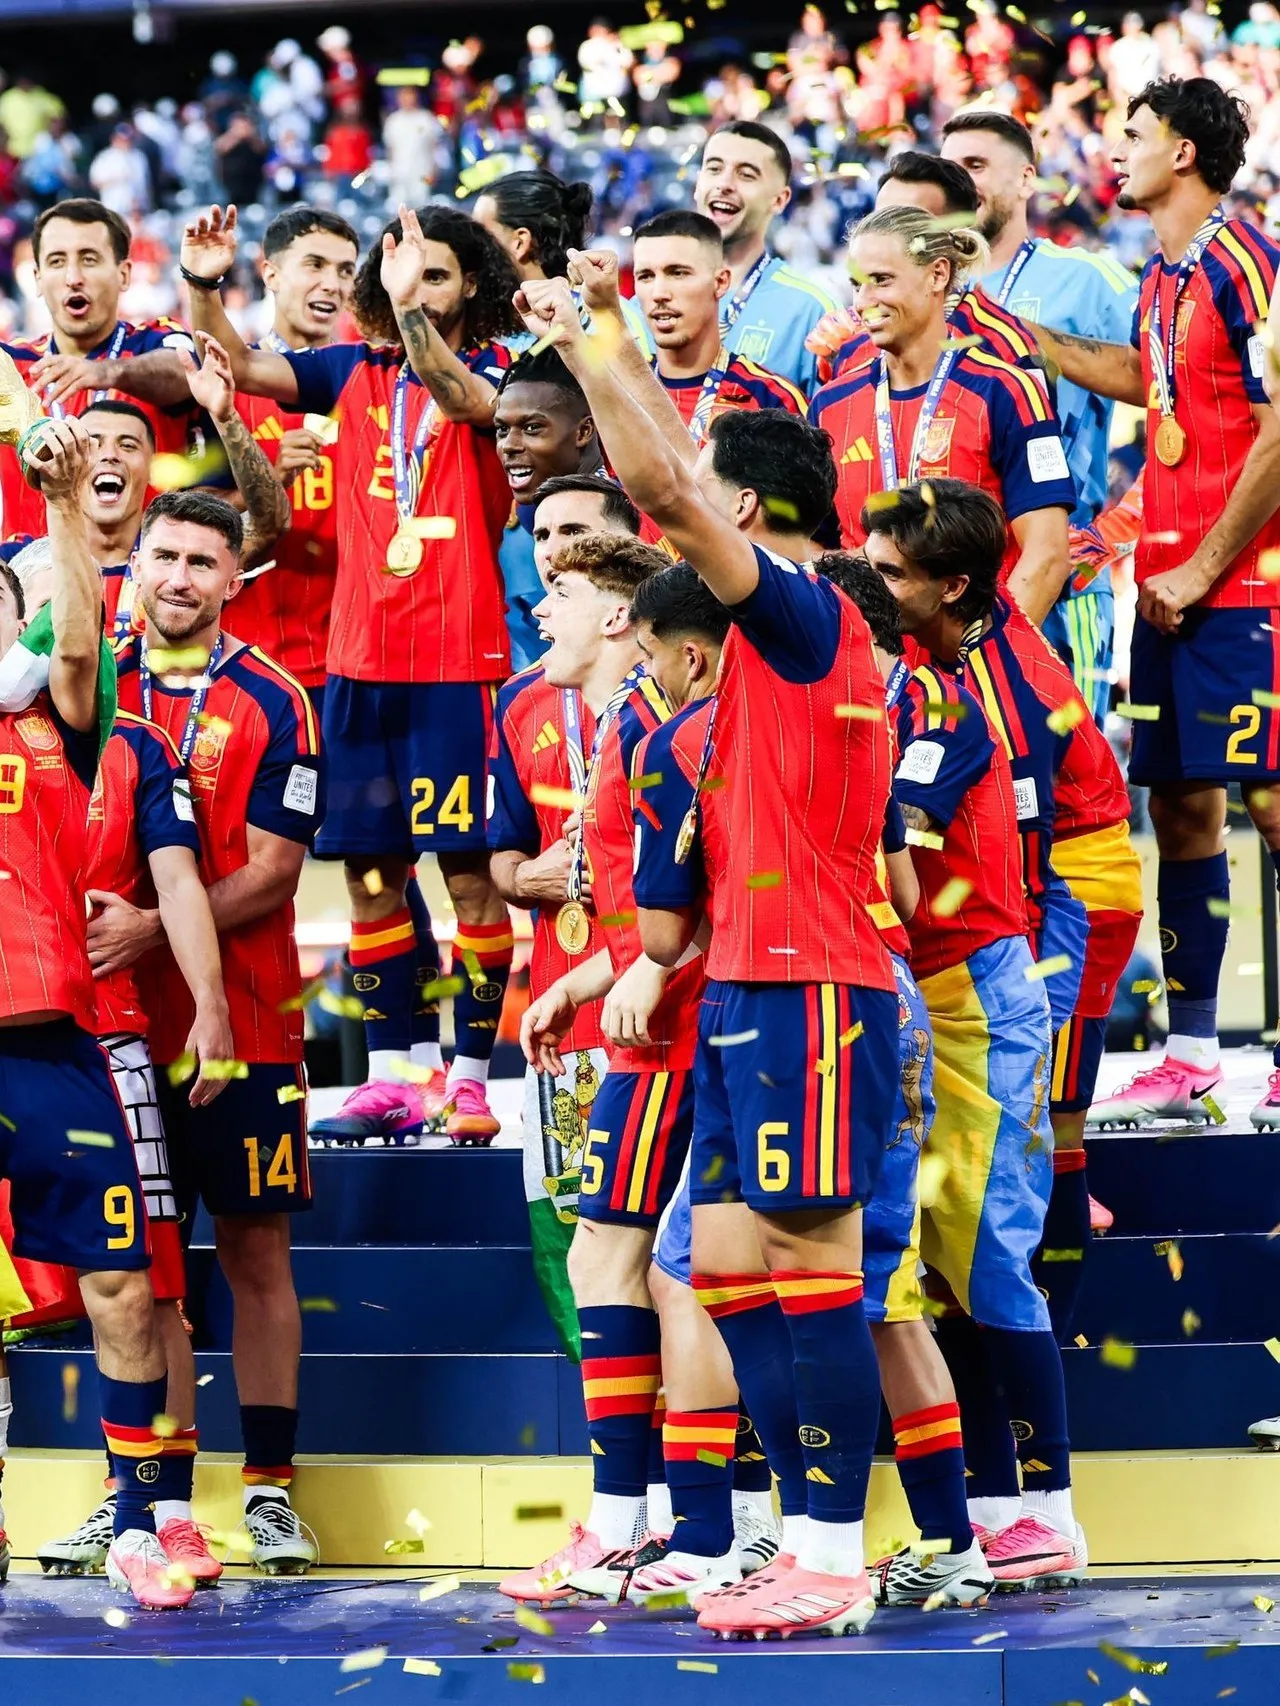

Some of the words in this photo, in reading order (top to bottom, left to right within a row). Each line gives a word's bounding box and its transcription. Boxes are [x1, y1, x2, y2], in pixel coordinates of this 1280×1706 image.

[930, 379, 943, 397] FIFA
[937, 350, 954, 380] WORLD
[293, 455, 333, 510] 18
[180, 738, 191, 760] FIFA
[185, 706, 199, 739] WORD
[1226, 704, 1260, 764] 2
[293, 780, 313, 793] UNITES
[411, 775, 474, 835] 24
[243, 1133, 297, 1197] 14
[757, 1122, 790, 1192] 6
[103, 1184, 135, 1250] 9
